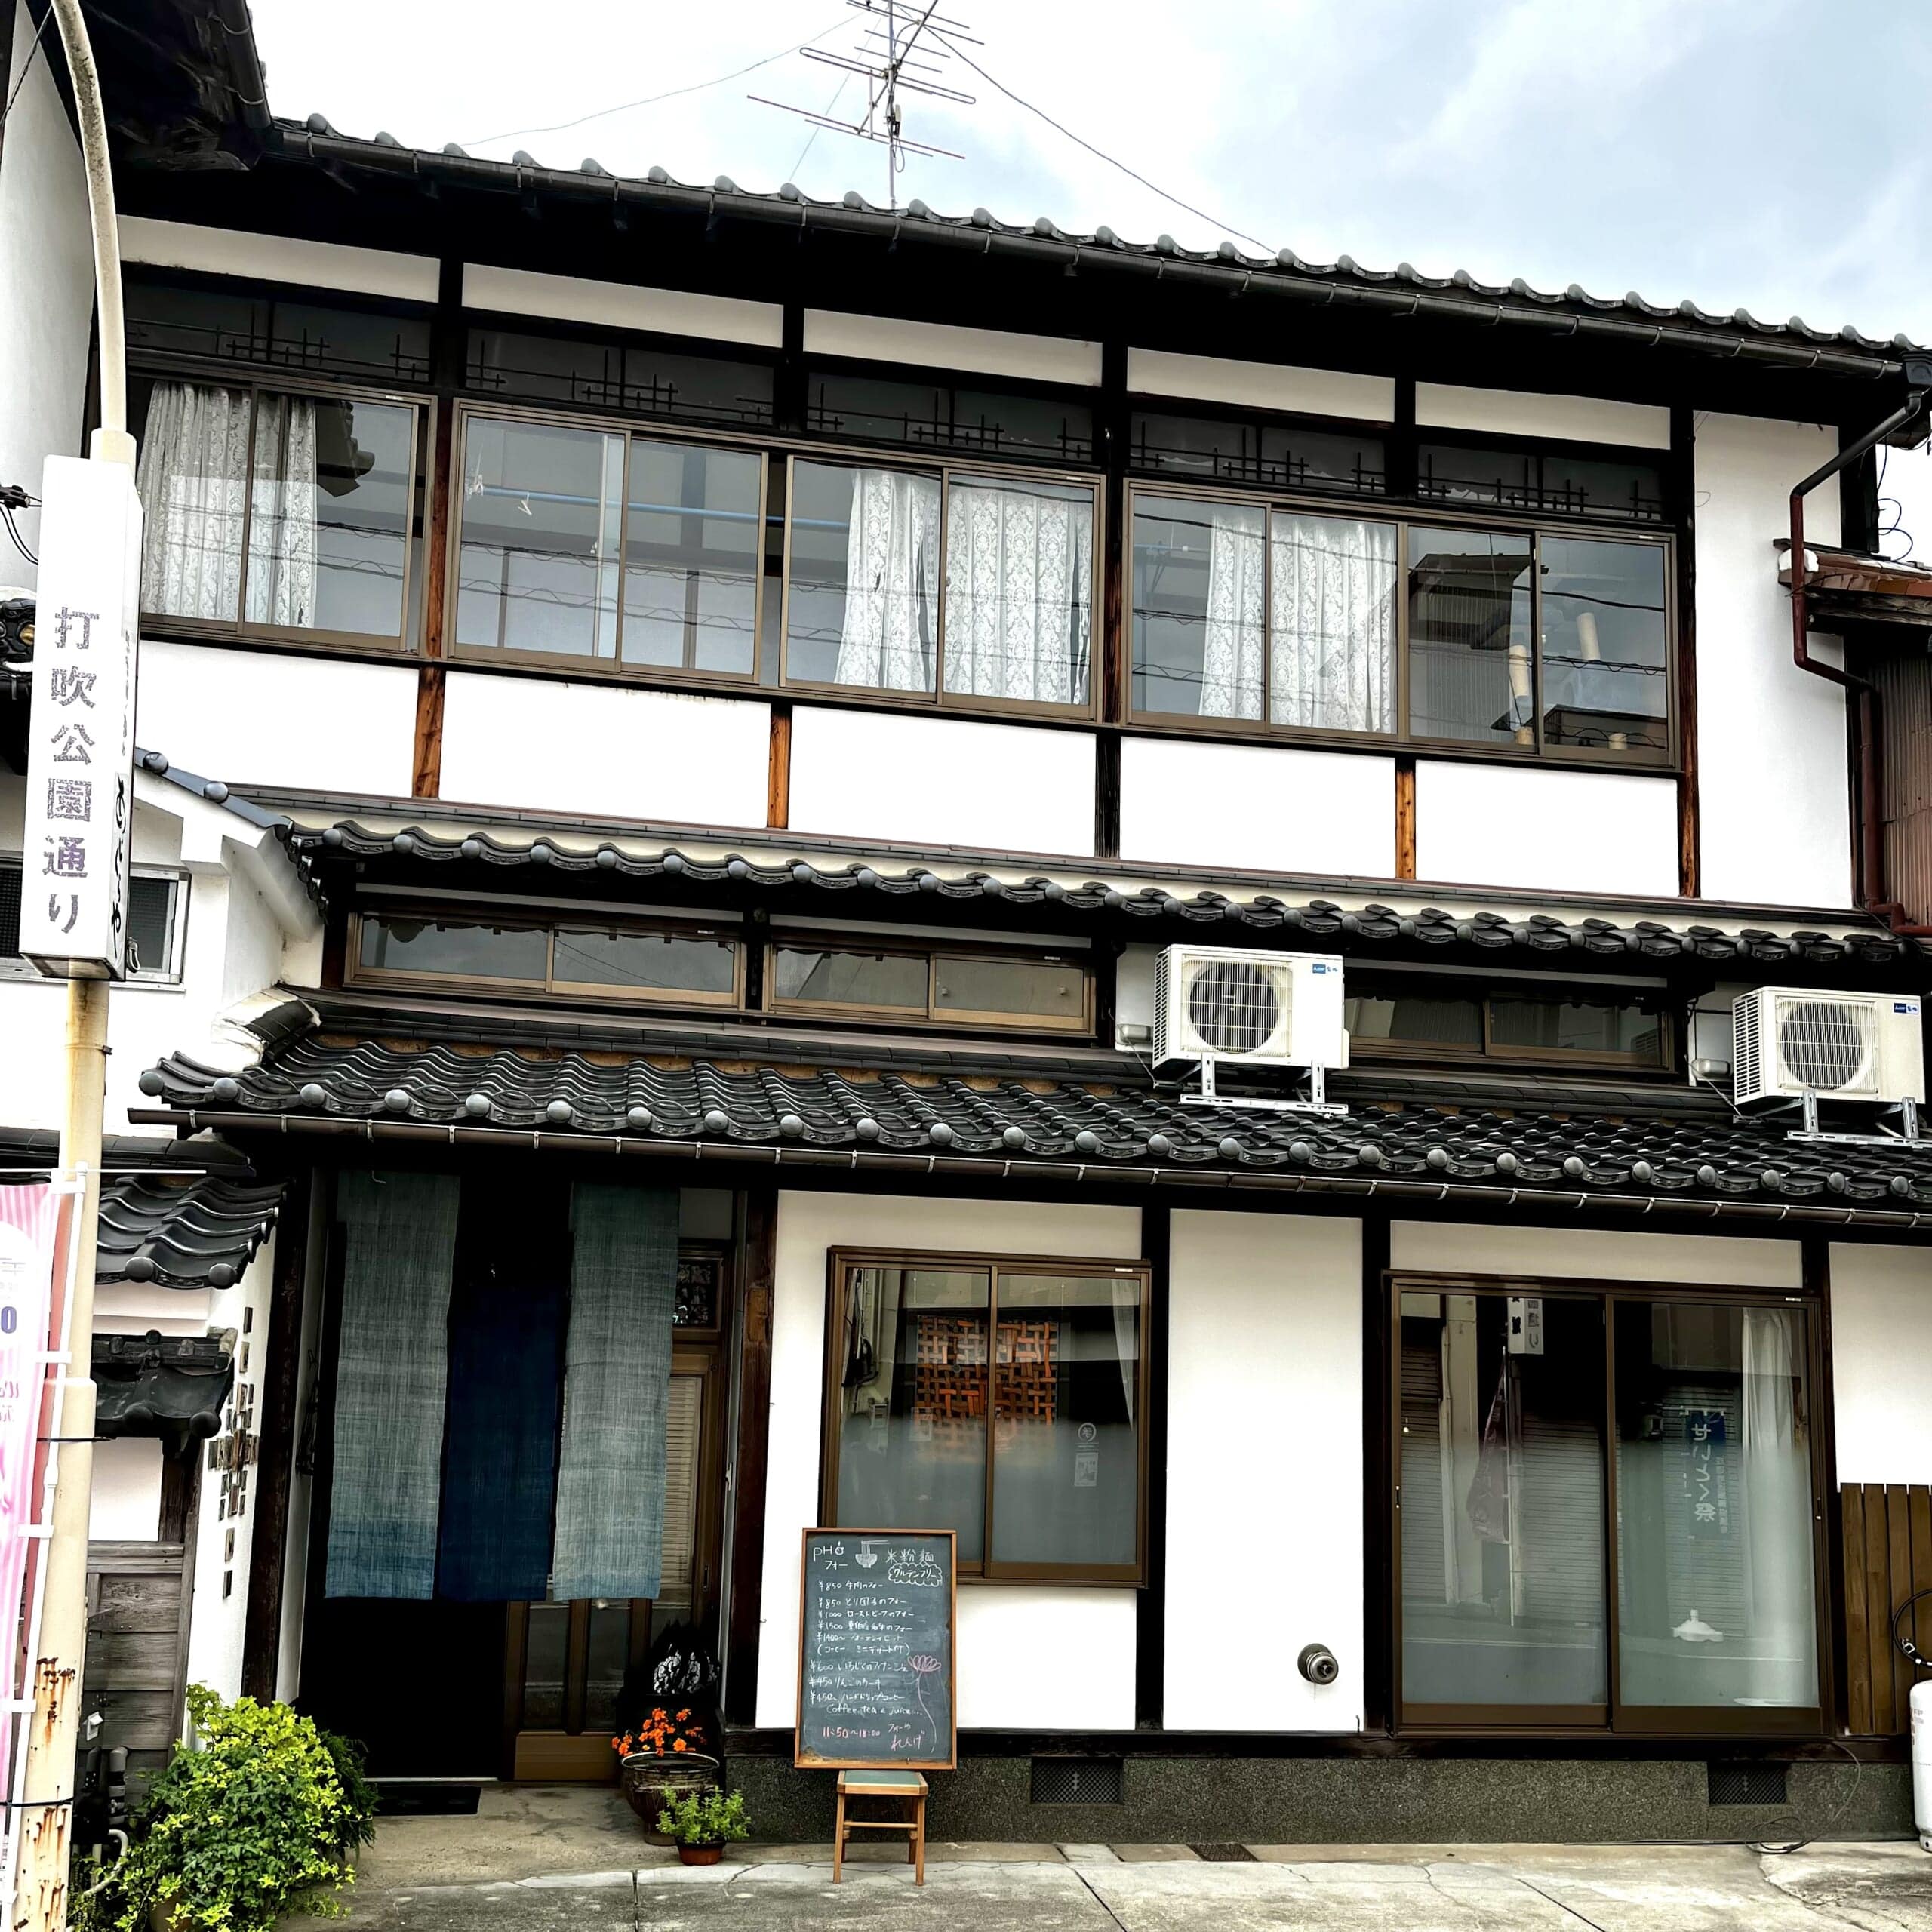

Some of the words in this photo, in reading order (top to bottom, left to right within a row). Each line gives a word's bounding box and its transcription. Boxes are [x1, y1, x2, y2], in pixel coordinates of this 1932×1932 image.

[42, 605, 100, 934] 打吹公園通り
[824, 1561, 848, 1571] フォー
[893, 1566, 937, 1580] グルテンフリー
[818, 1580, 842, 1592] ¥850
[818, 1597, 841, 1609] ¥850
[818, 1610, 843, 1619] ¥1000
[817, 1619, 843, 1631] ¥1500
[861, 1705, 878, 1715] tea
